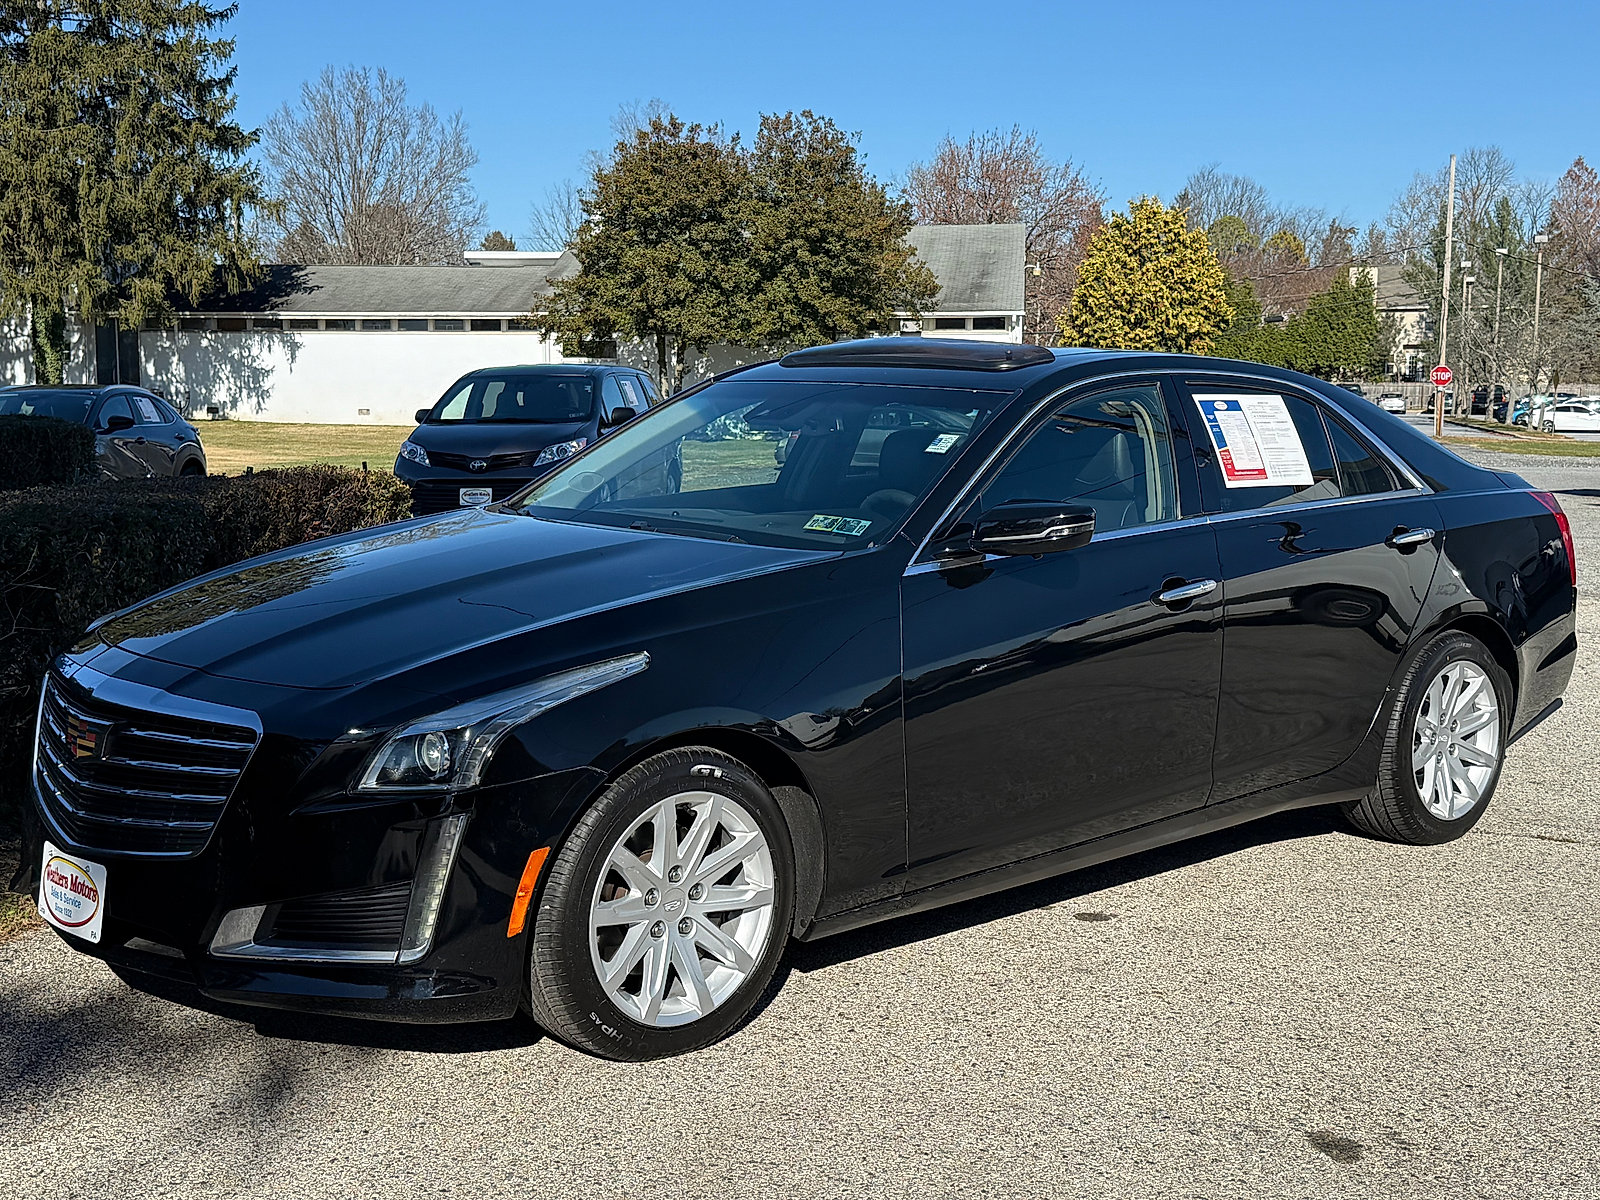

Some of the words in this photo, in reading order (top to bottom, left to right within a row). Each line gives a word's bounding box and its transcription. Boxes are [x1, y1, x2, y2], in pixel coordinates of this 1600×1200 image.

[1432, 371, 1451, 381] STOP
[69, 873, 98, 903] Motors
[63, 892, 82, 909] Service
[54, 902, 63, 914] Since
[90, 930, 98, 940] PA
[589, 1011, 603, 1025] AS
